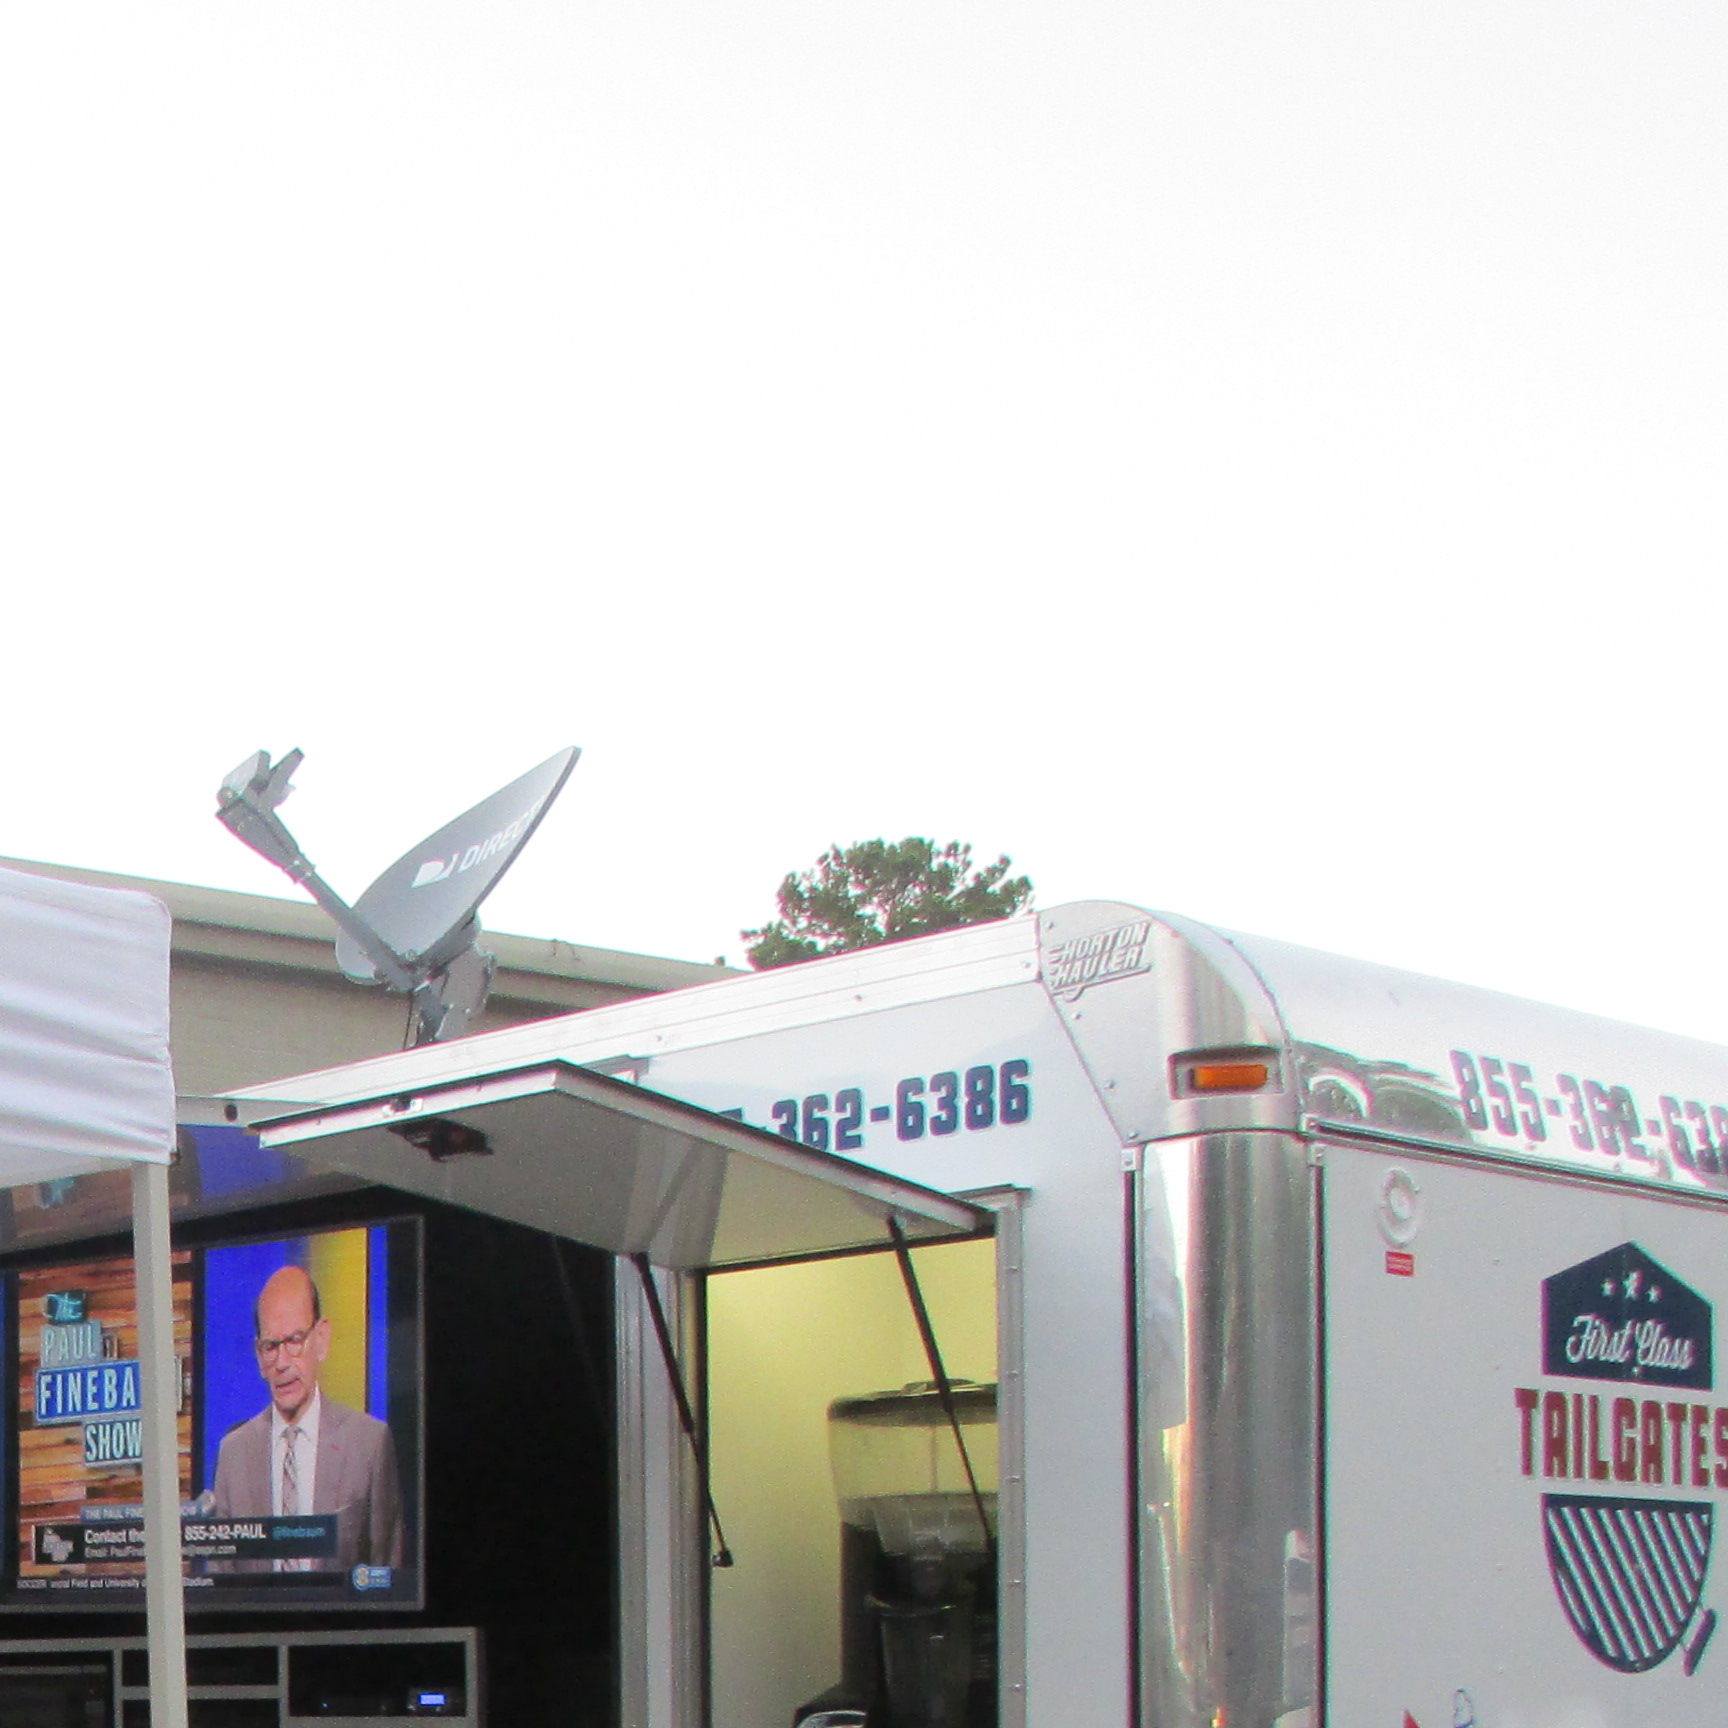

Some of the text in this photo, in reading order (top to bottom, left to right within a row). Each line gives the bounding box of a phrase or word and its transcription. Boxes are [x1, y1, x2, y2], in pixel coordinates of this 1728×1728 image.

[1058, 921, 1152, 962] HORTON
[1051, 944, 1144, 989] HAULER
[44, 1324, 98, 1362] PAUL
[1565, 1314, 1694, 1370] First Class
[40, 1365, 138, 1416] FINEBA
[85, 1421, 142, 1462] SHOW
[184, 1523, 266, 1541] 855-242-PAUL
